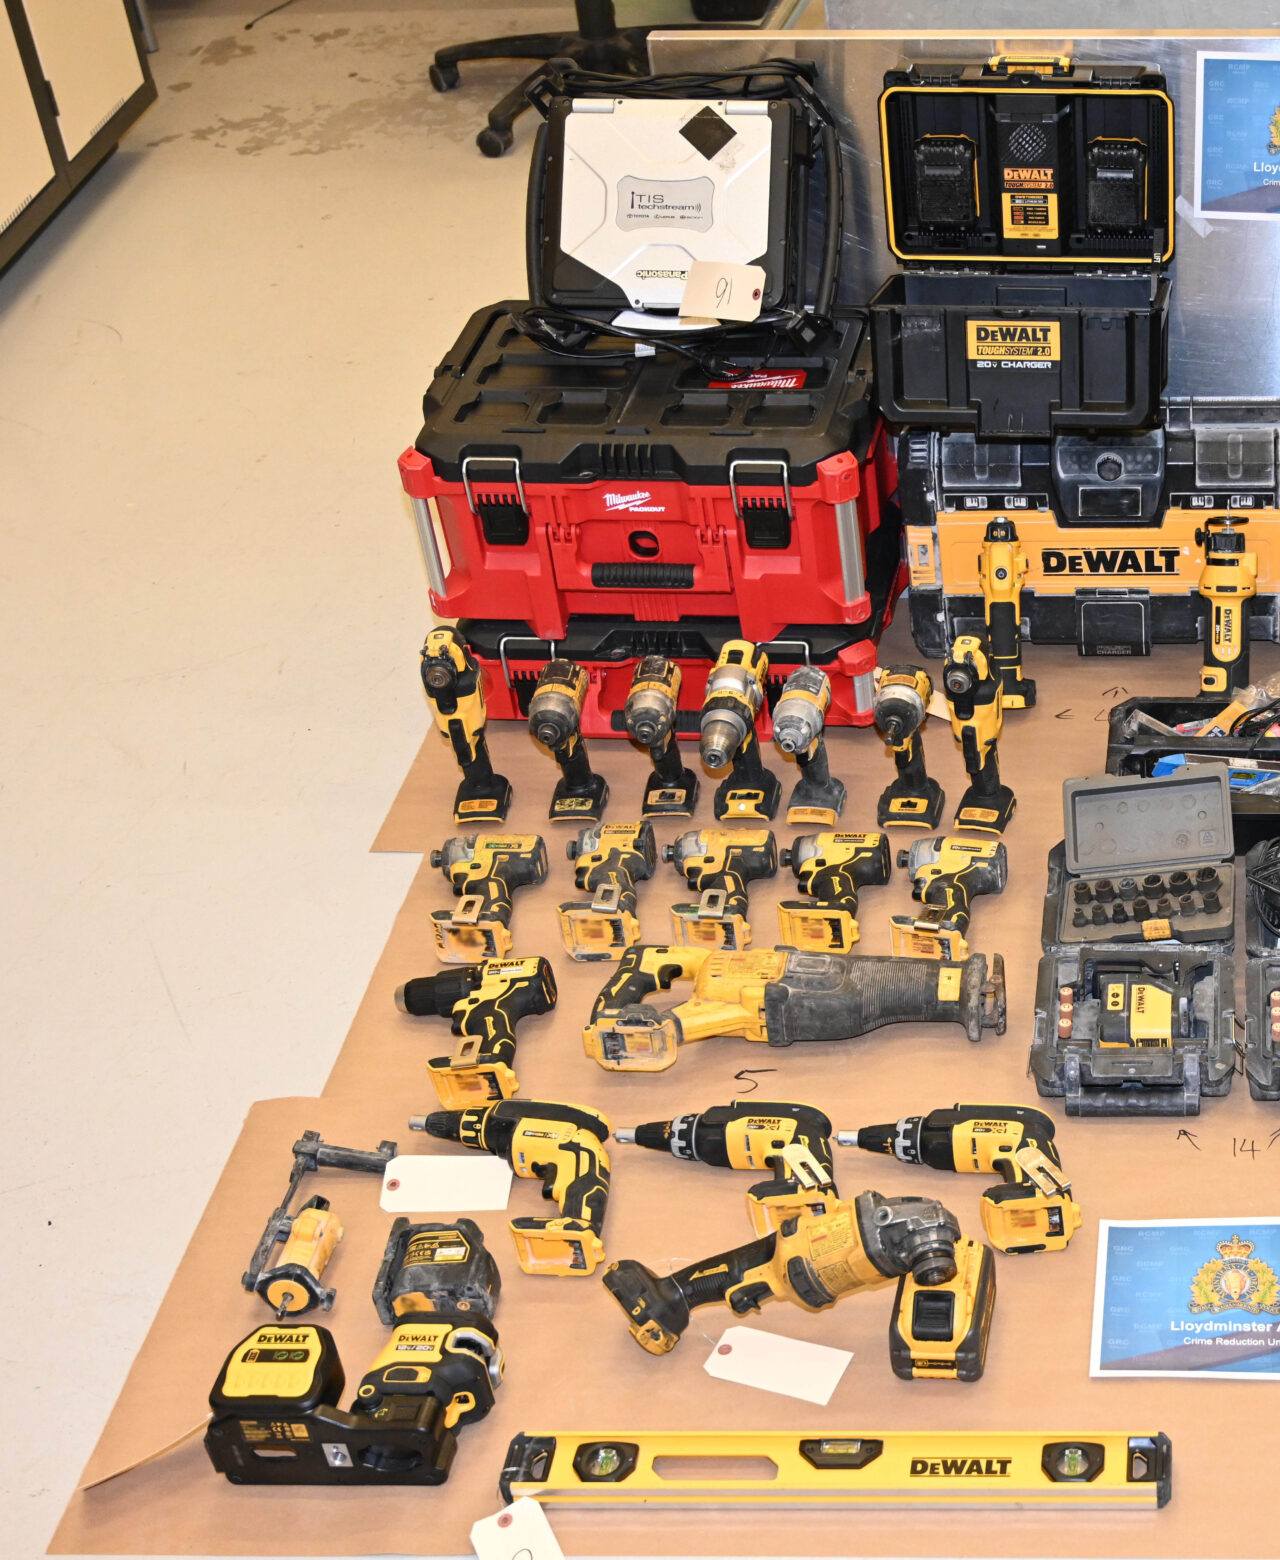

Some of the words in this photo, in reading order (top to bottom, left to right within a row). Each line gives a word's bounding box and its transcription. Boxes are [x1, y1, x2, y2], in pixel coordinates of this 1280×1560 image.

[1004, 168, 1054, 180] DEWALT
[636, 194, 665, 204] TIS
[638, 203, 695, 211] techstream
[636, 269, 689, 280] Panasonic
[976, 327, 1051, 342] DEWALT
[978, 346, 1034, 356] TOUGHSYSTEM
[1037, 347, 1050, 356] 2.0
[1001, 361, 1052, 369] CHARGER
[603, 490, 651, 507] Milwaukee
[1041, 550, 1181, 573] DEWALT
[1224, 609, 1232, 643] DEWALT
[488, 960, 526, 969] DEWALT
[1137, 987, 1145, 1014] DEWALT
[733, 1068, 778, 1094] 5
[1232, 1137, 1262, 1160] 14
[1170, 1320, 1273, 1333] Lloydminster
[257, 1335, 309, 1344] DEWALT
[1183, 1337, 1213, 1346] Crime
[1215, 1337, 1266, 1347] Reduction
[910, 1459, 1012, 1475] DEWALT
